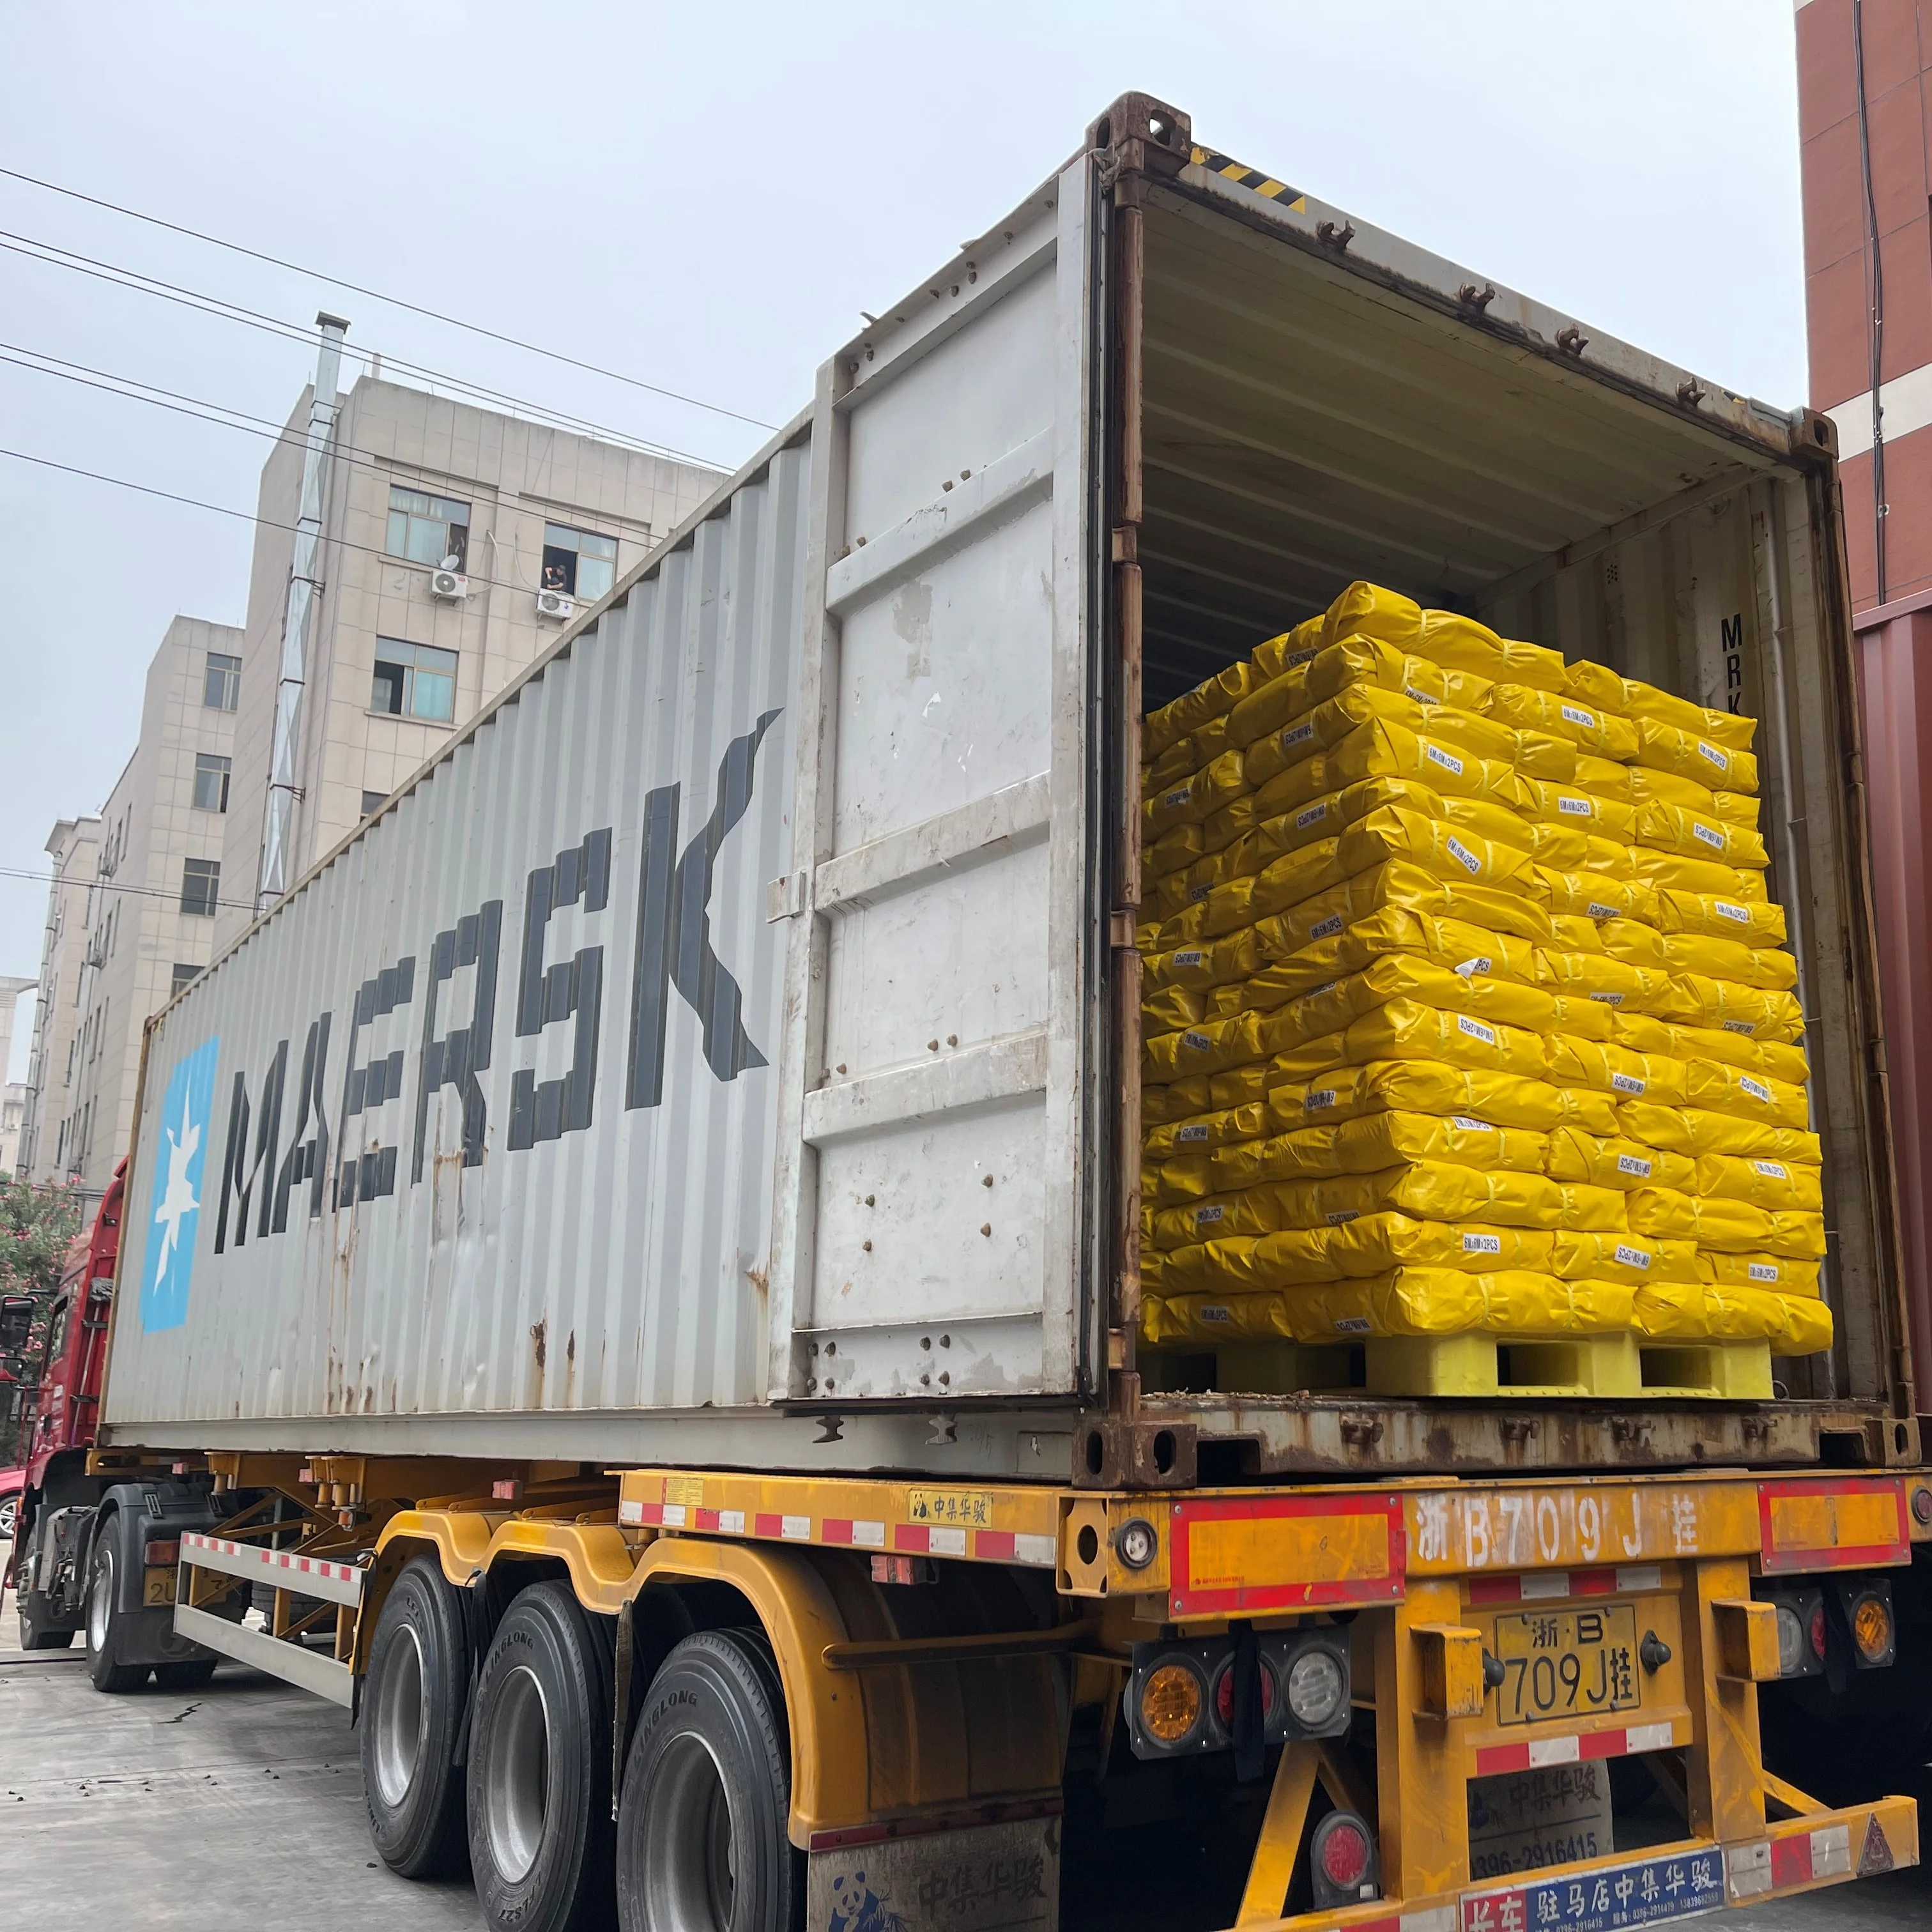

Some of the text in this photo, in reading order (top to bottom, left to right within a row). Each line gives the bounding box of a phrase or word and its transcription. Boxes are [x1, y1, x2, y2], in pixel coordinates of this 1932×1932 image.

[214, 707, 785, 1254] MAERSK
[934, 1495, 987, 1523] 中集华骏
[1505, 1648, 1633, 1715] 709J挂
[1537, 1857, 1717, 1924] 驻马店中集华骏
